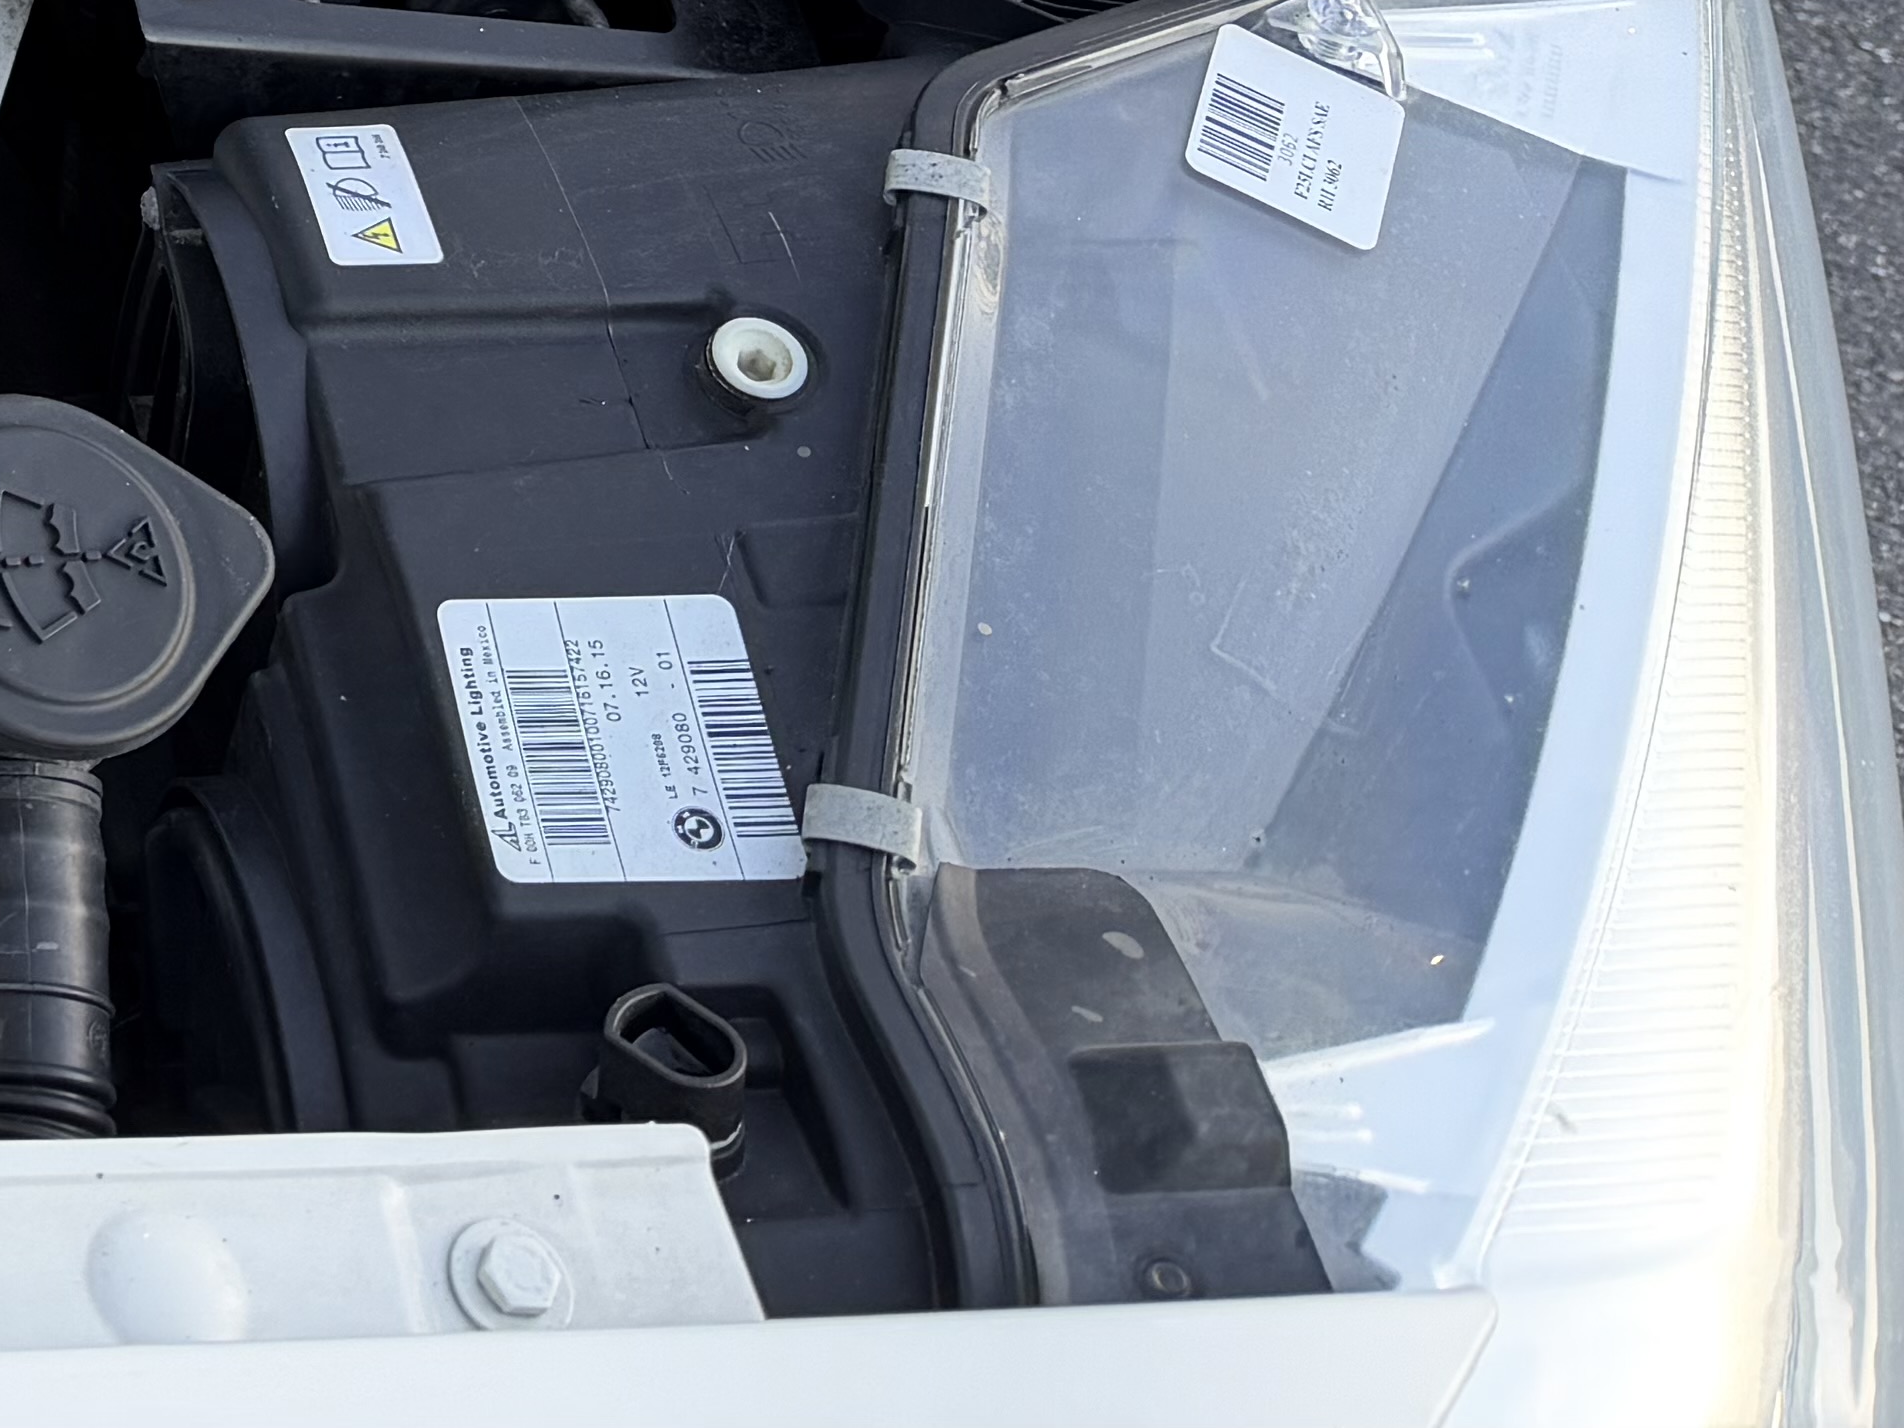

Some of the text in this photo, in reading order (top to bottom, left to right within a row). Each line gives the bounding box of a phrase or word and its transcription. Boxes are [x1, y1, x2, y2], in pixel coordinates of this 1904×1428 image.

[1277, 132, 1300, 167] 3062
[459, 646, 484, 718] Lighting
[487, 670, 498, 684] in
[587, 639, 622, 722] 07.16.15
[628, 666, 649, 697] 12V
[656, 650, 673, 671] 01
[491, 691, 514, 750] Assembled
[671, 712, 703, 776] 429080
[473, 722, 507, 820] Automotive
[691, 787, 708, 797] 7
